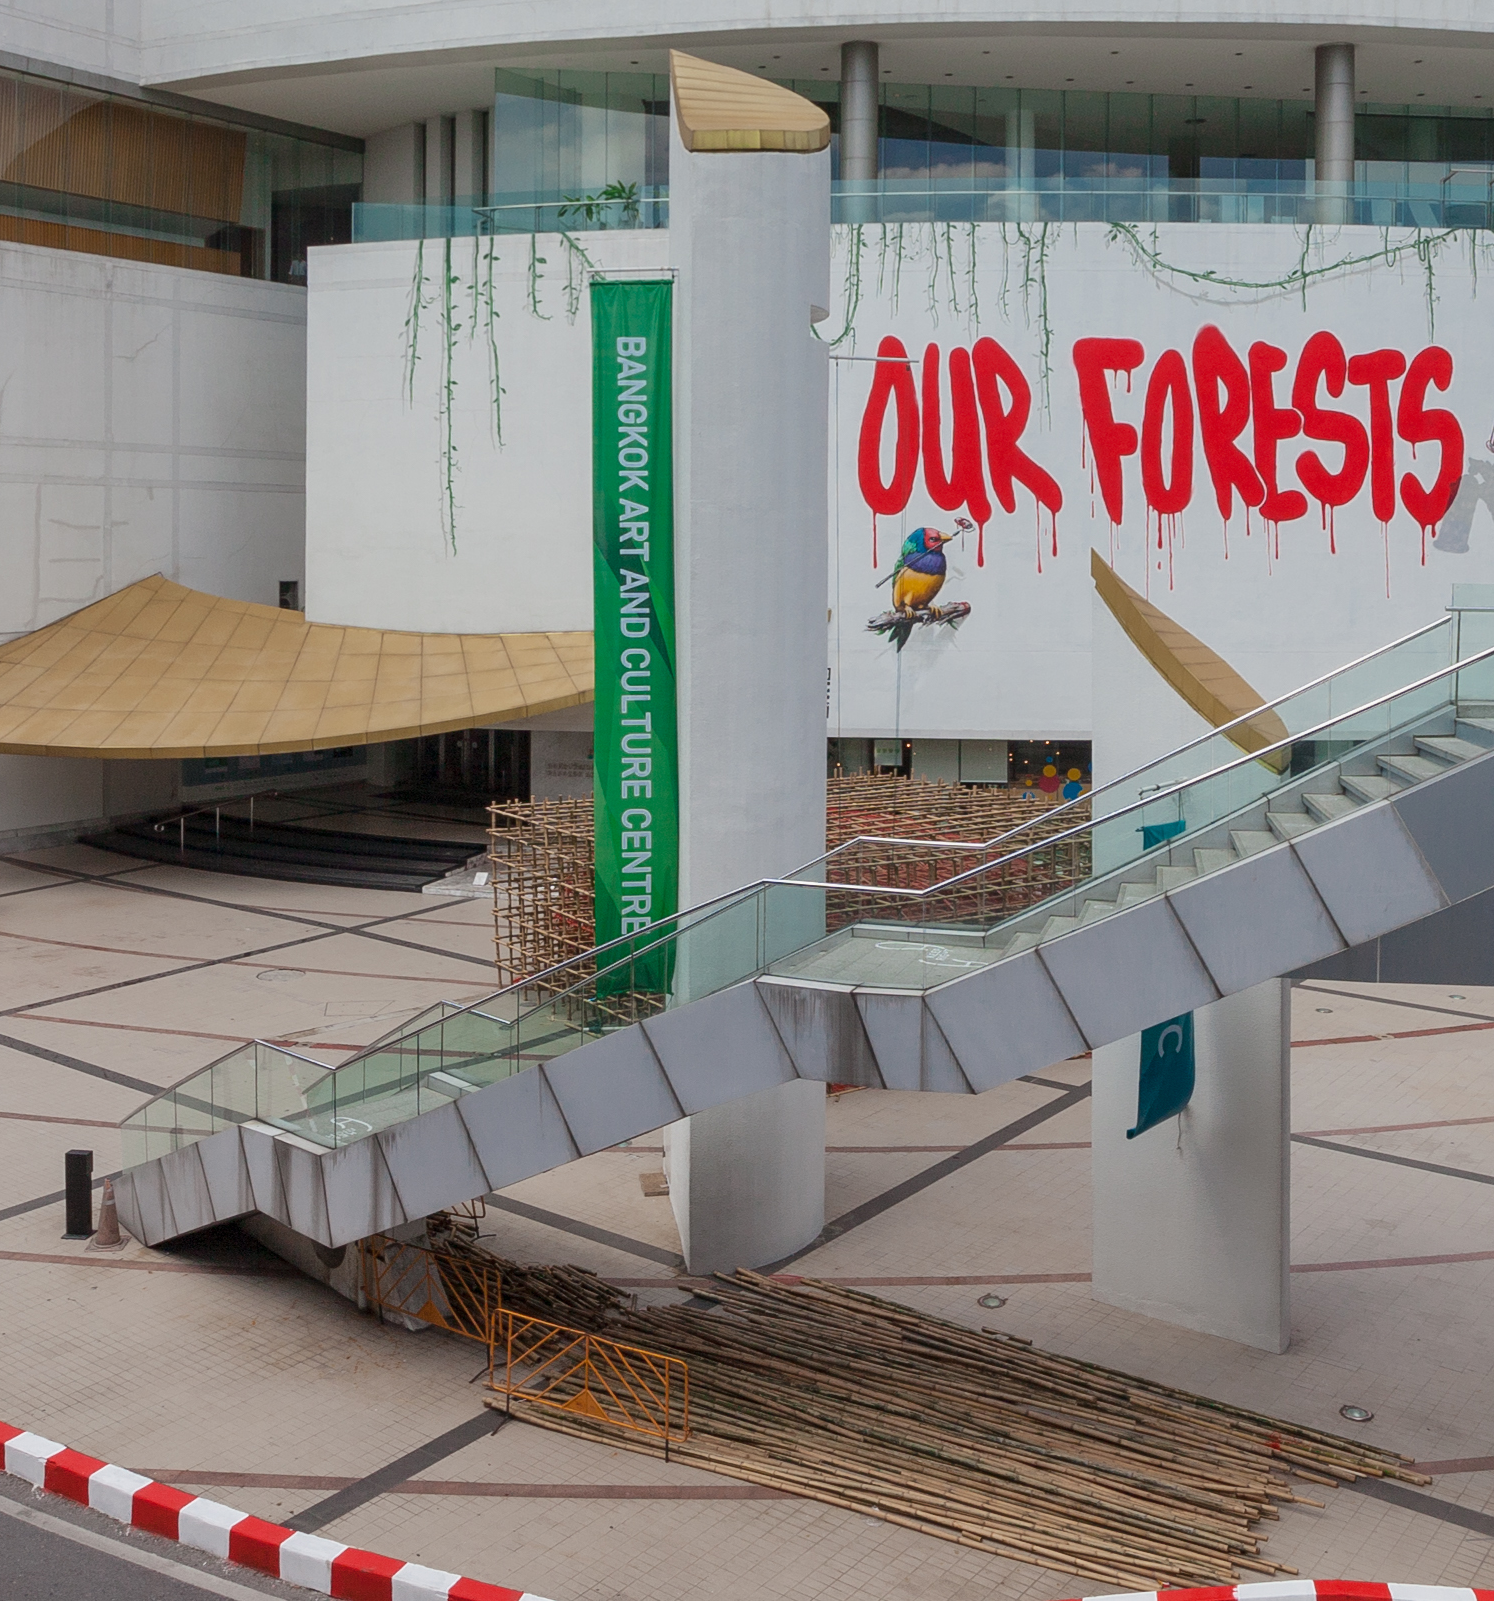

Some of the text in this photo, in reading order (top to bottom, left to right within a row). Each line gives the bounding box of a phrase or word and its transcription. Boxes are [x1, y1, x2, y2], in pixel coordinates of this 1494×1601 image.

[858, 324, 1465, 526] OUR FORESTS
[616, 336, 652, 935] BANGKOK ART AND CULTURE CENTRE
